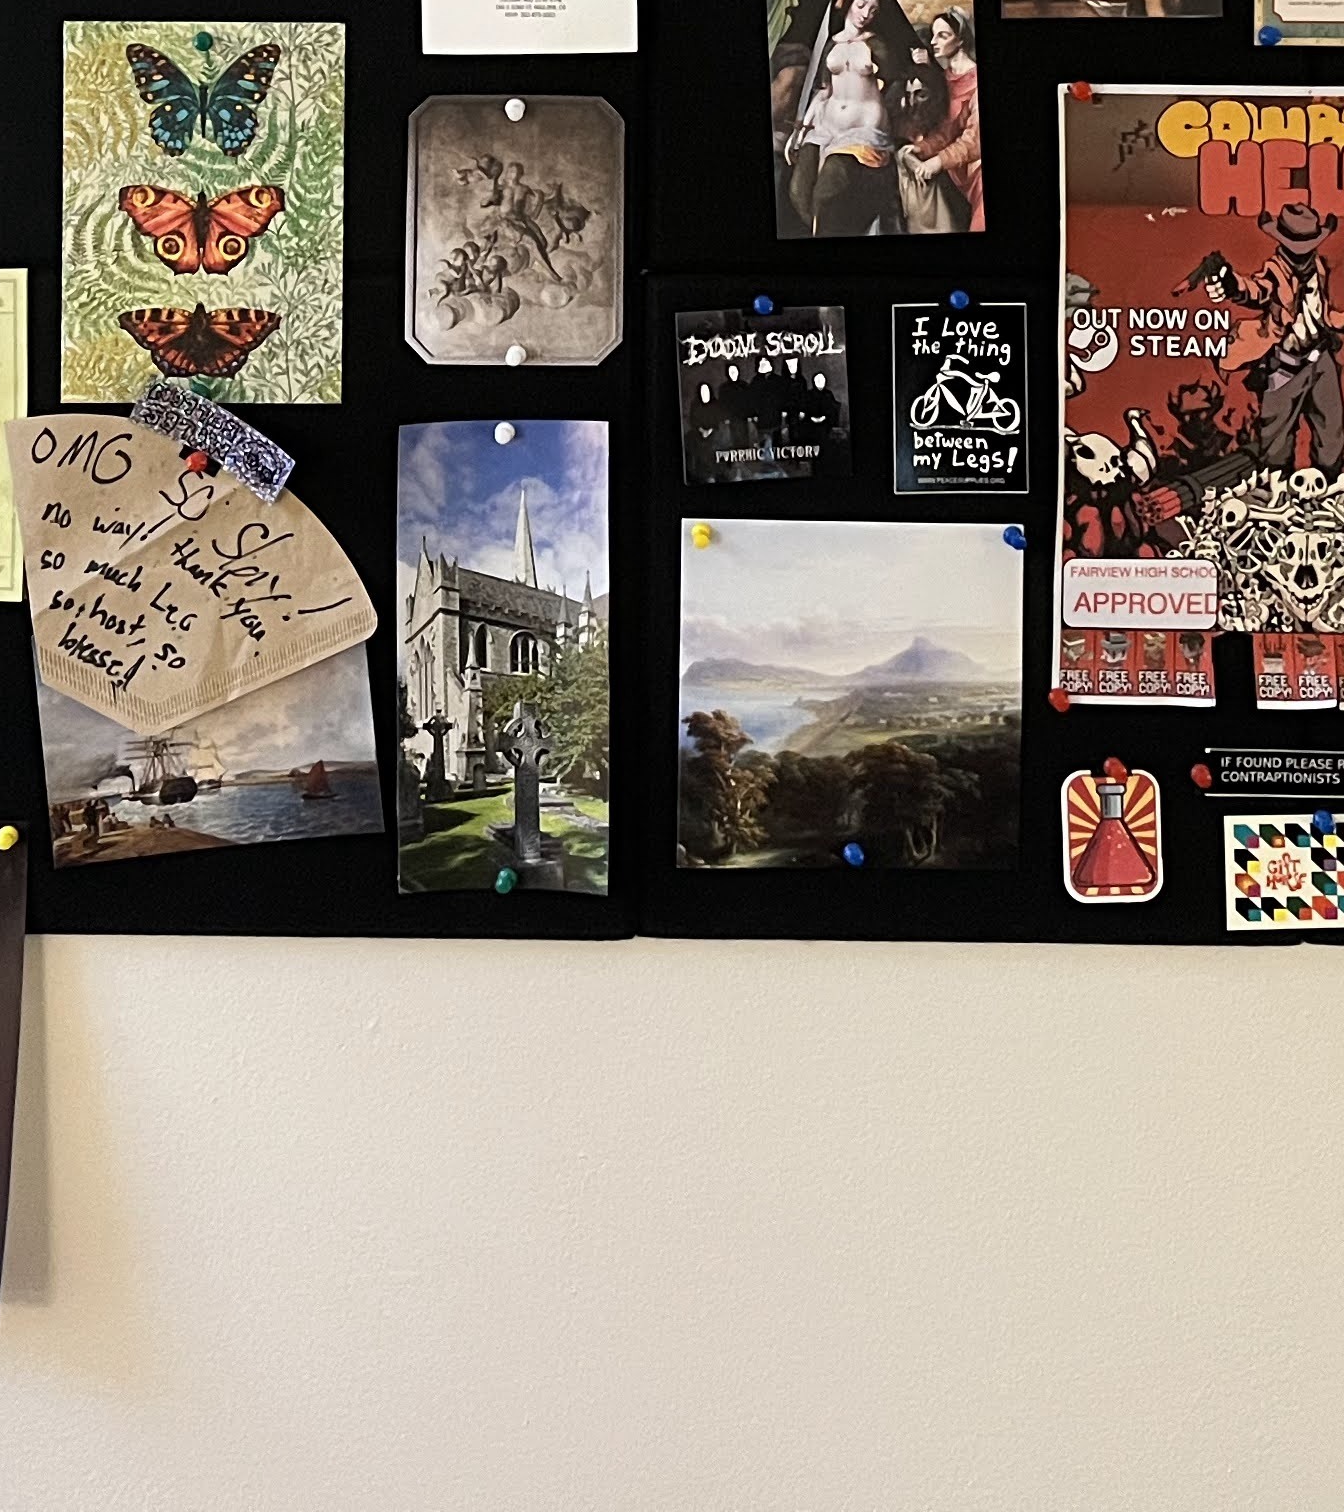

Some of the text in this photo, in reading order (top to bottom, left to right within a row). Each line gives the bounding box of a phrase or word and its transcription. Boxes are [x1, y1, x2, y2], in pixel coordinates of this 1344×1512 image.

[912, 318, 999, 338] I Love
[1073, 309, 1229, 330] OUT NOW ON
[681, 325, 845, 365] DOOM SCROLL
[912, 338, 1011, 365] the thing
[1130, 336, 1227, 357] STEAM
[914, 432, 987, 450] between
[31, 428, 132, 484] OMG
[914, 447, 1018, 474] my Legs!
[42, 502, 71, 528] no
[85, 560, 141, 590] much
[1070, 566, 1168, 578] FAIRVIEW HIGH
[1073, 592, 1220, 615] APPROVED
[1099, 670, 1128, 682] FREE
[1099, 682, 1131, 694] COPY!
[1221, 758, 1231, 769] IF
[1236, 758, 1281, 769] FOUND
[1286, 758, 1333, 769] PLEASE
[1220, 772, 1340, 784] CONTRAPTIONISTS
